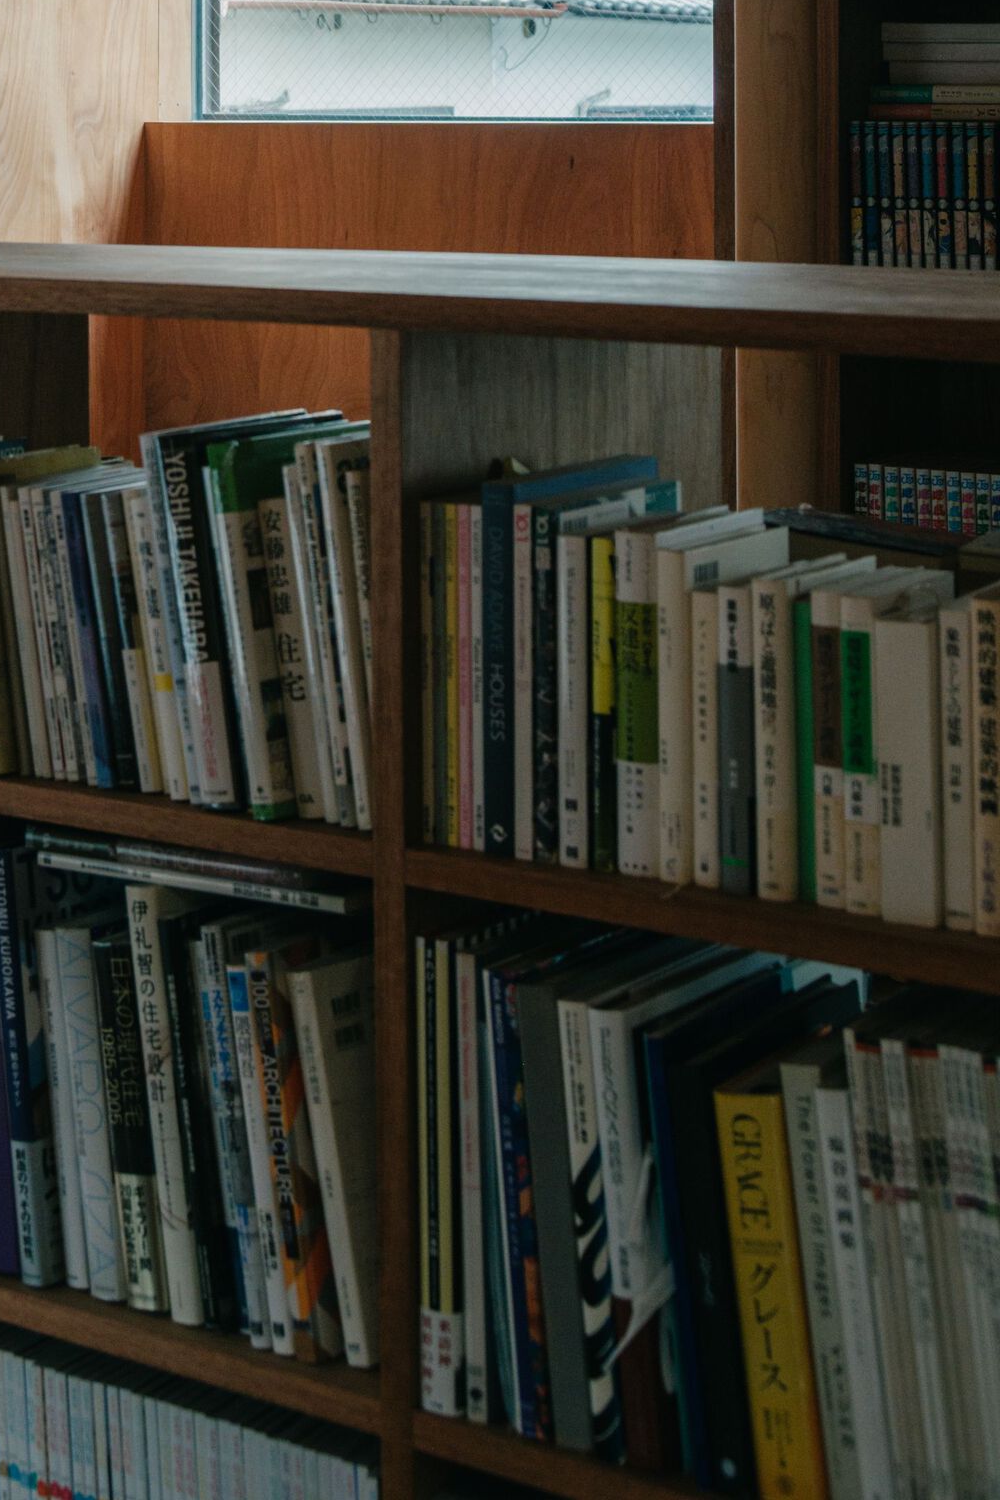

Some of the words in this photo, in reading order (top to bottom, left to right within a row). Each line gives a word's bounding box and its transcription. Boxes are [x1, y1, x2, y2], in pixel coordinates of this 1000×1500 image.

[264, 509, 292, 615] 安藤忠雄
[278, 633, 306, 702] 住宅
[488, 525, 505, 583] DAVID
[490, 661, 506, 741] HOUSES
[0, 931, 18, 1020] KUROKAWA
[132, 900, 165, 1103] 伊礼智の住宅設計
[101, 1027, 123, 1125] 1985-2005
[110, 956, 144, 1128] 日本の現代住宅
[259, 1053, 292, 1205] ARCHITECTURE
[730, 1113, 770, 1230] GRACE
[748, 1262, 788, 1393] グレース
